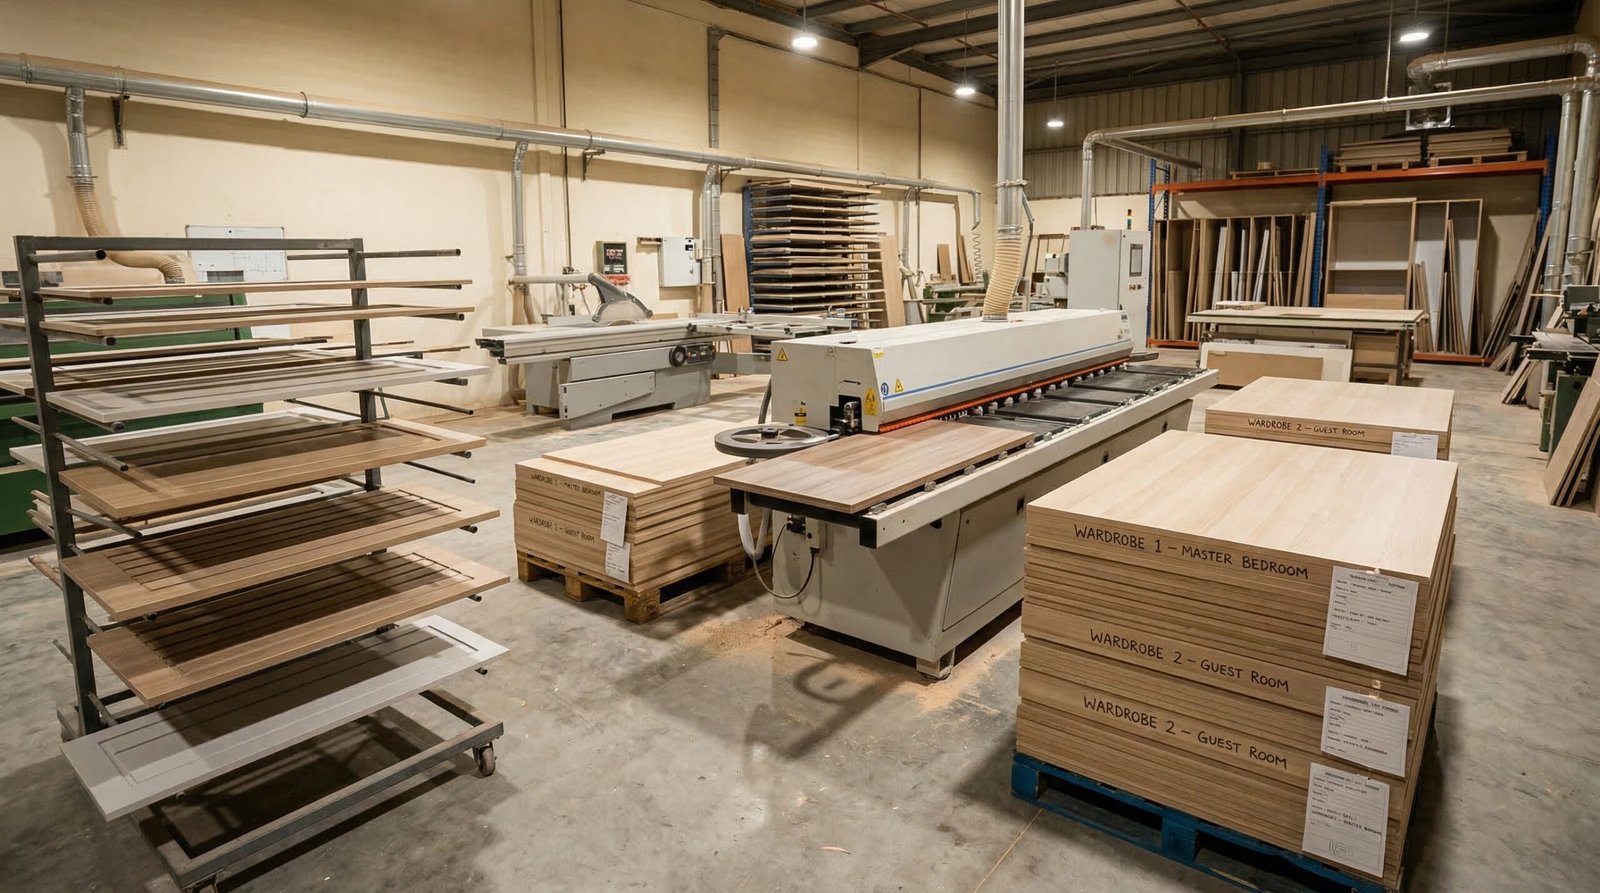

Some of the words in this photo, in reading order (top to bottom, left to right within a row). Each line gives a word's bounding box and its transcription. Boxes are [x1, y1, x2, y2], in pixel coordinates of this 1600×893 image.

[1248, 418, 1291, 430] WARDROBE
[1296, 423, 1302, 431] 2
[1313, 426, 1338, 434] GUEST
[1342, 428, 1365, 437] ROOM
[1074, 524, 1145, 550] WARDROBE
[1155, 539, 1162, 553] 1
[1182, 545, 1233, 565] MASTER
[1242, 556, 1309, 579] BEDROOM
[1090, 628, 1164, 659] WARDROBE
[1173, 651, 1183, 664] 2
[1200, 659, 1244, 679] GUEST
[1251, 671, 1289, 692] ROOM
[1084, 695, 1157, 729] WARDROBE
[1165, 720, 1176, 735] 2
[1197, 730, 1242, 753] GUEST
[1249, 746, 1288, 769] ROOM
